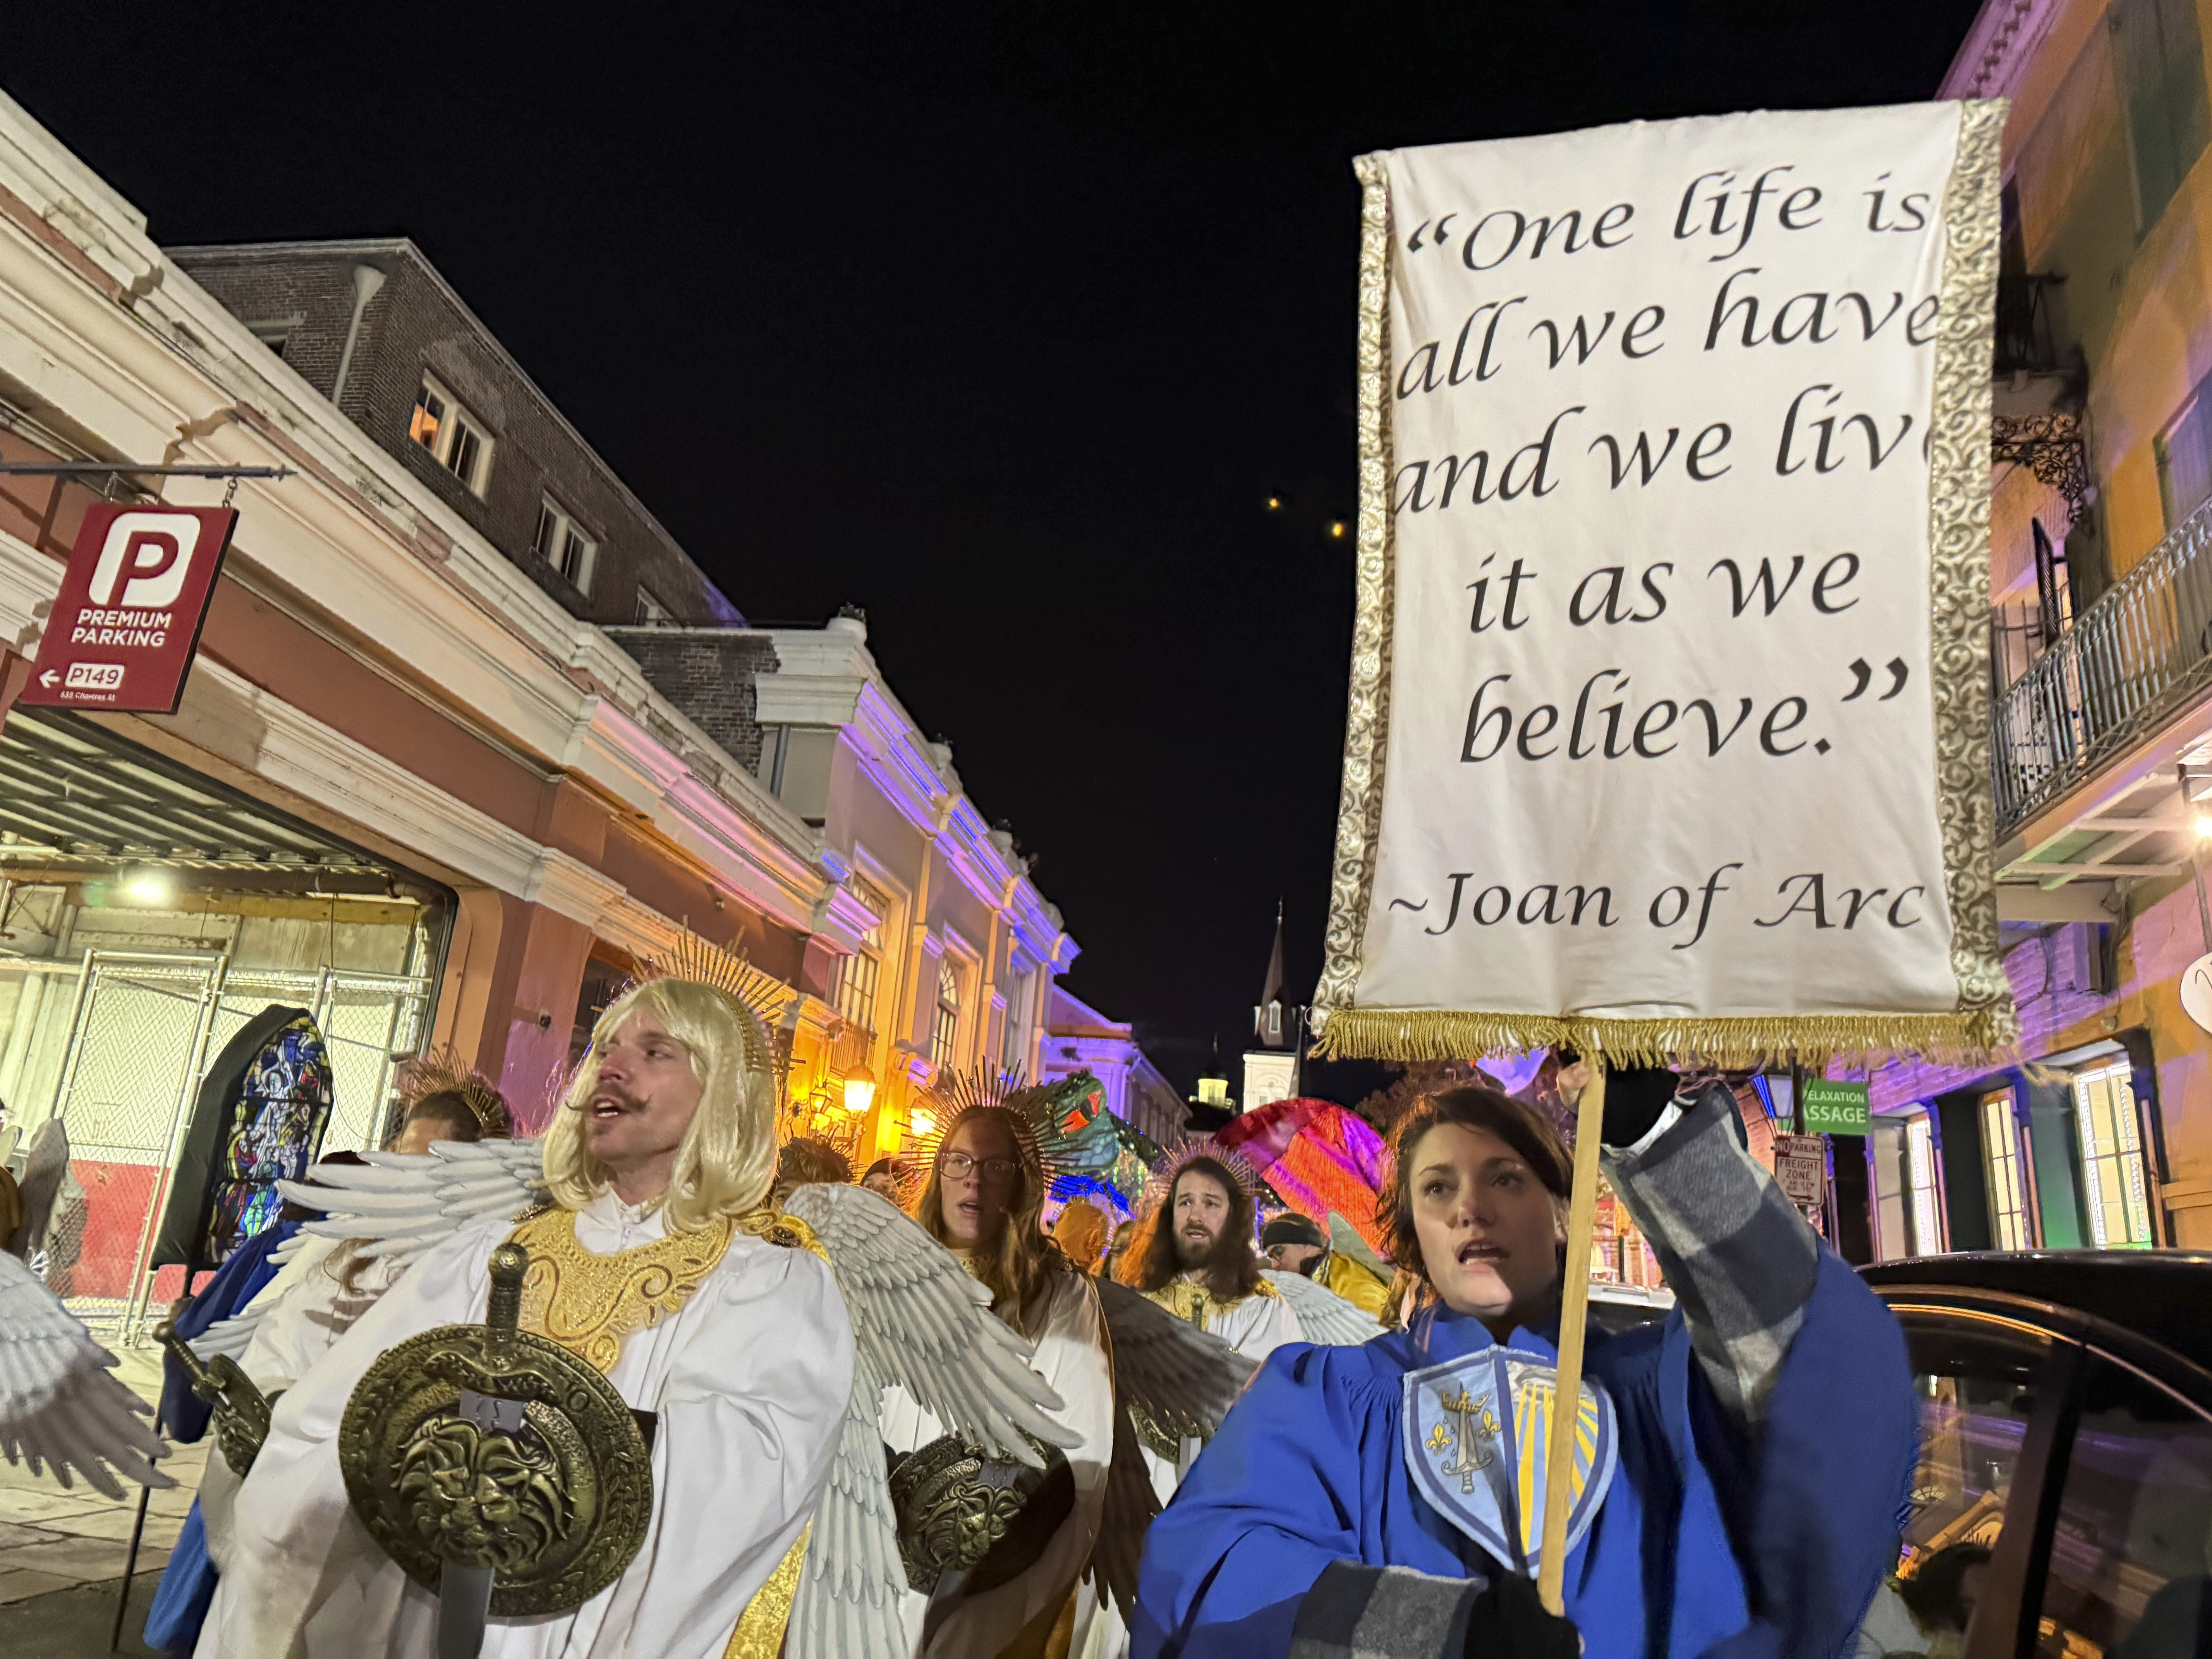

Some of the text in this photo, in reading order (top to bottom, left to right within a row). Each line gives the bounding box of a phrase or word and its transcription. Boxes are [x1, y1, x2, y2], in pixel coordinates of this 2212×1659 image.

[1408, 166, 1930, 271] “One life is
[1397, 267, 1939, 400] all we have
[1394, 383, 1936, 516] and we liv
[77, 608, 172, 629] PREMIUM
[1465, 552, 1860, 634] it as we
[70, 627, 165, 647] PARKING
[69, 668, 119, 685] P149
[1460, 657, 1909, 763] believe.”
[1649, 862, 1744, 950] of
[1753, 872, 1925, 930] Arc
[1776, 1140, 1821, 1154] NO PARKING
[1779, 1158, 1818, 1170] FREIGHT
[1786, 1169, 1810, 1180] ZONE
